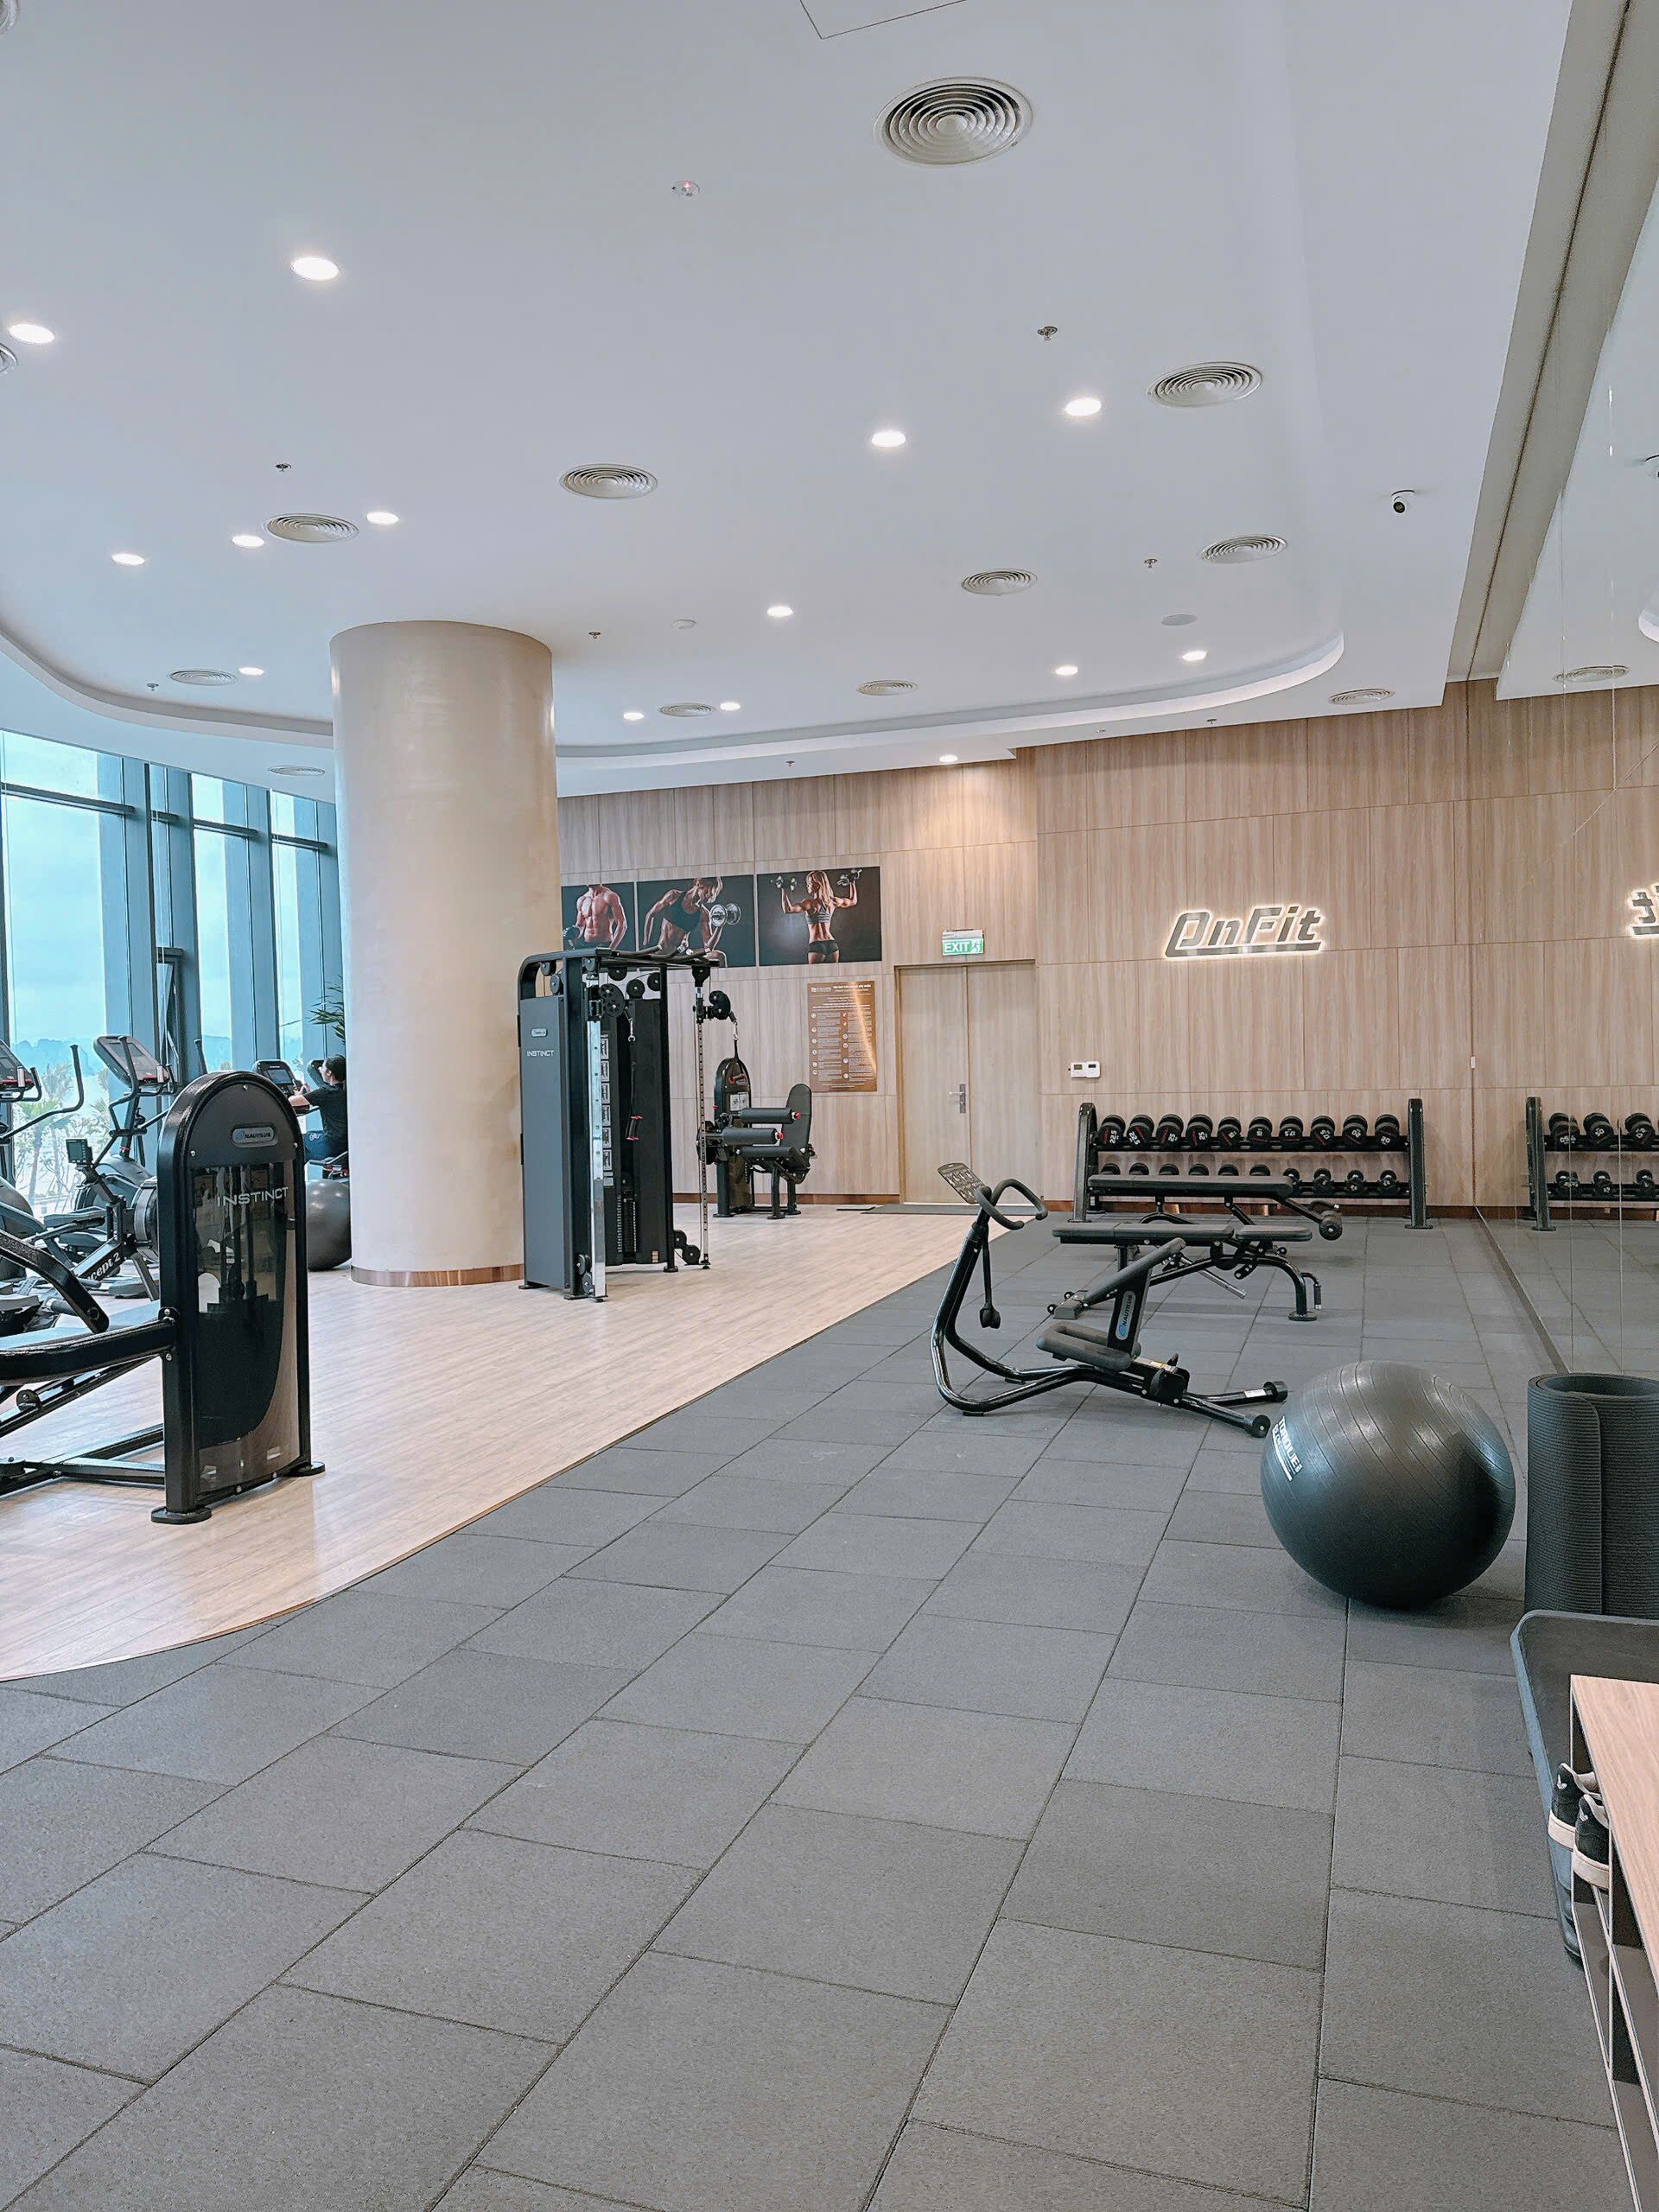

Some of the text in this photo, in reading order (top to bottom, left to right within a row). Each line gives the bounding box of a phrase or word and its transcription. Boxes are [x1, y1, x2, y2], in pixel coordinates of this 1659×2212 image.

[1165, 906, 1322, 957] OnFit
[944, 942, 969, 952] EXIT
[1109, 1129, 1117, 1144] 22.5
[1128, 1131, 1141, 1146] 22.5
[1168, 1132, 1176, 1142] 25
[1198, 1131, 1206, 1141] 25
[1351, 1129, 1362, 1138] 20
[217, 1186, 289, 1207] INSTINCT
[113, 1252, 121, 1262] 2
[1122, 1294, 1132, 1327] NAUTILUS
